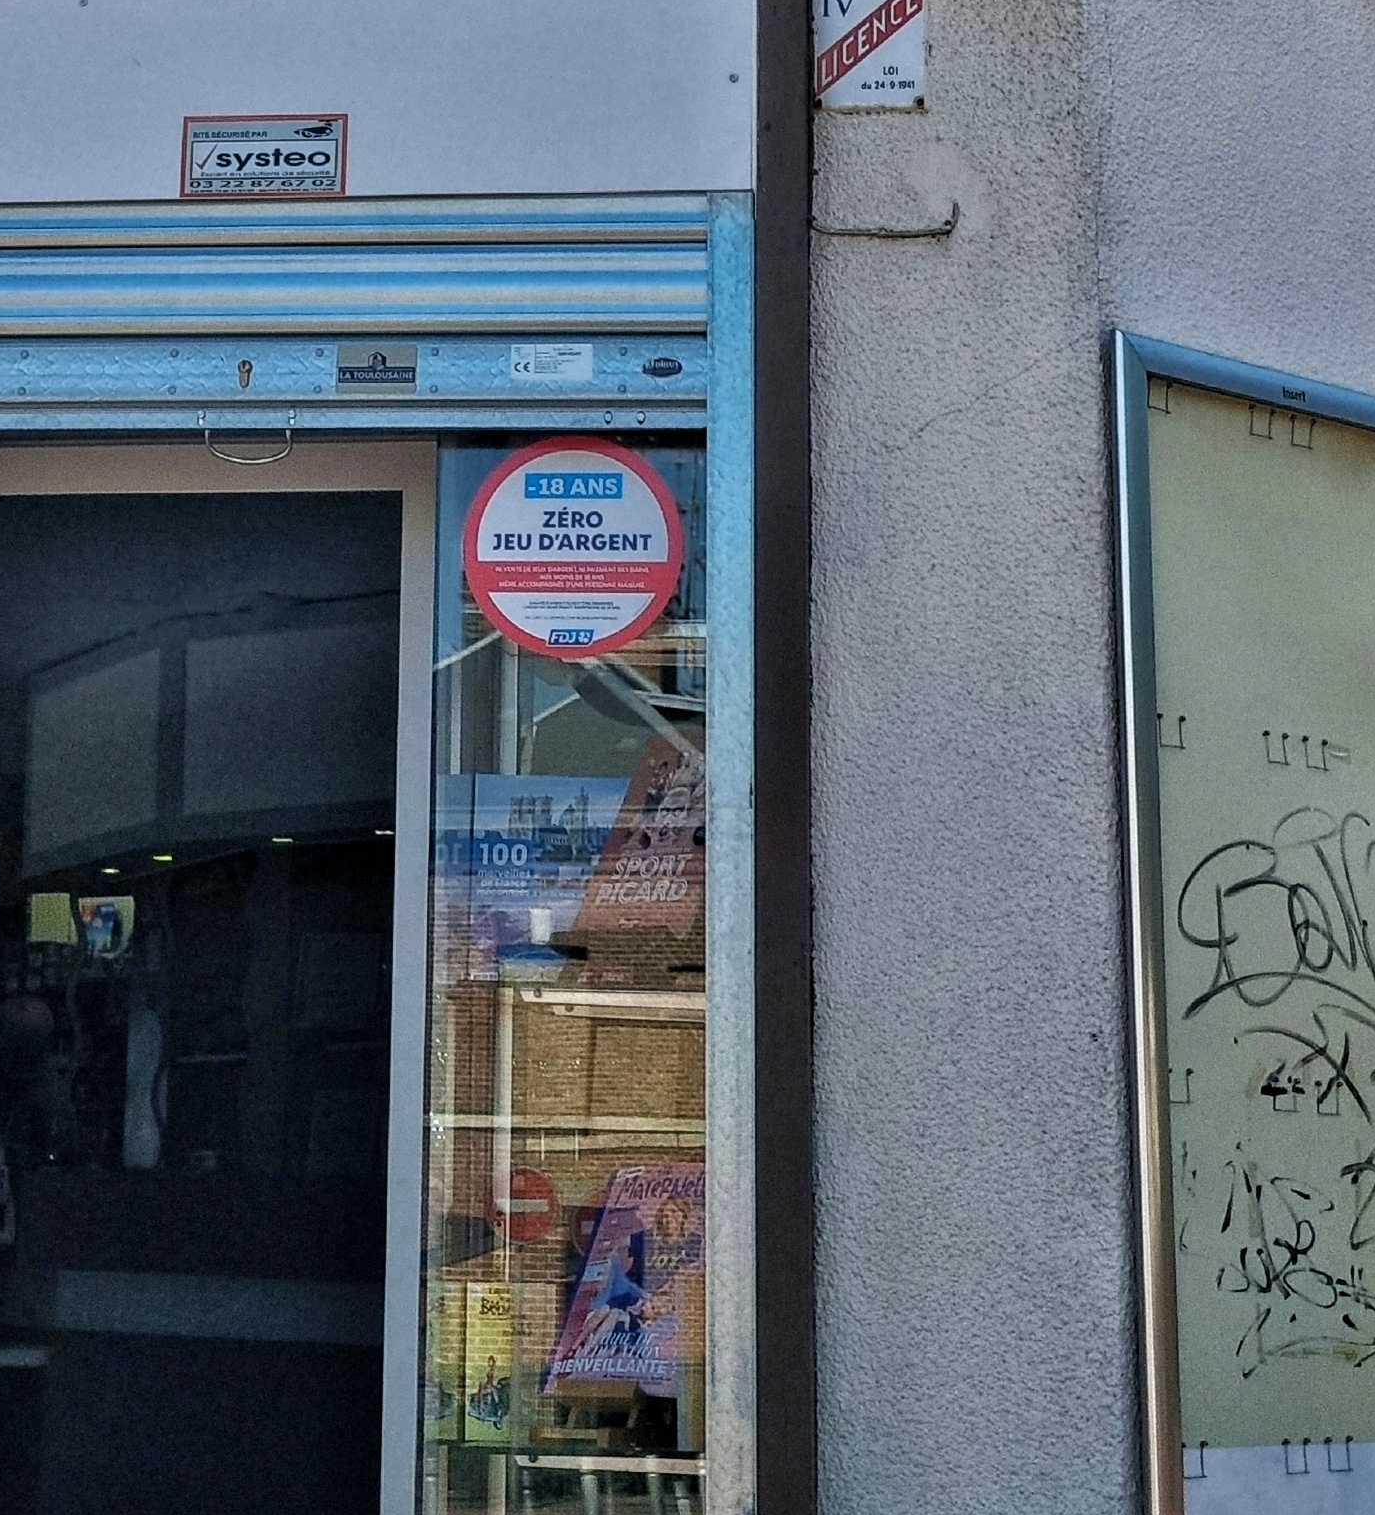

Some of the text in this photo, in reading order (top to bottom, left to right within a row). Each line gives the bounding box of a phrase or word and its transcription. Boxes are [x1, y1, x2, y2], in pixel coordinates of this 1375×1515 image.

[883, 66, 898, 76] LOI
[861, 80, 872, 90] du
[216, 148, 331, 171] systeo
[189, 179, 336, 189] 03 22 87 67 02
[528, 478, 618, 496] -18 ANS
[542, 507, 603, 528] ZÉRO
[493, 533, 652, 551] JEU D'ARGENT
[550, 631, 575, 643] FDJ
[479, 843, 528, 866] 100
[612, 854, 693, 880] SPORT
[595, 879, 688, 905] PICARD
[552, 1357, 669, 1374] BIENVEILLANTE
